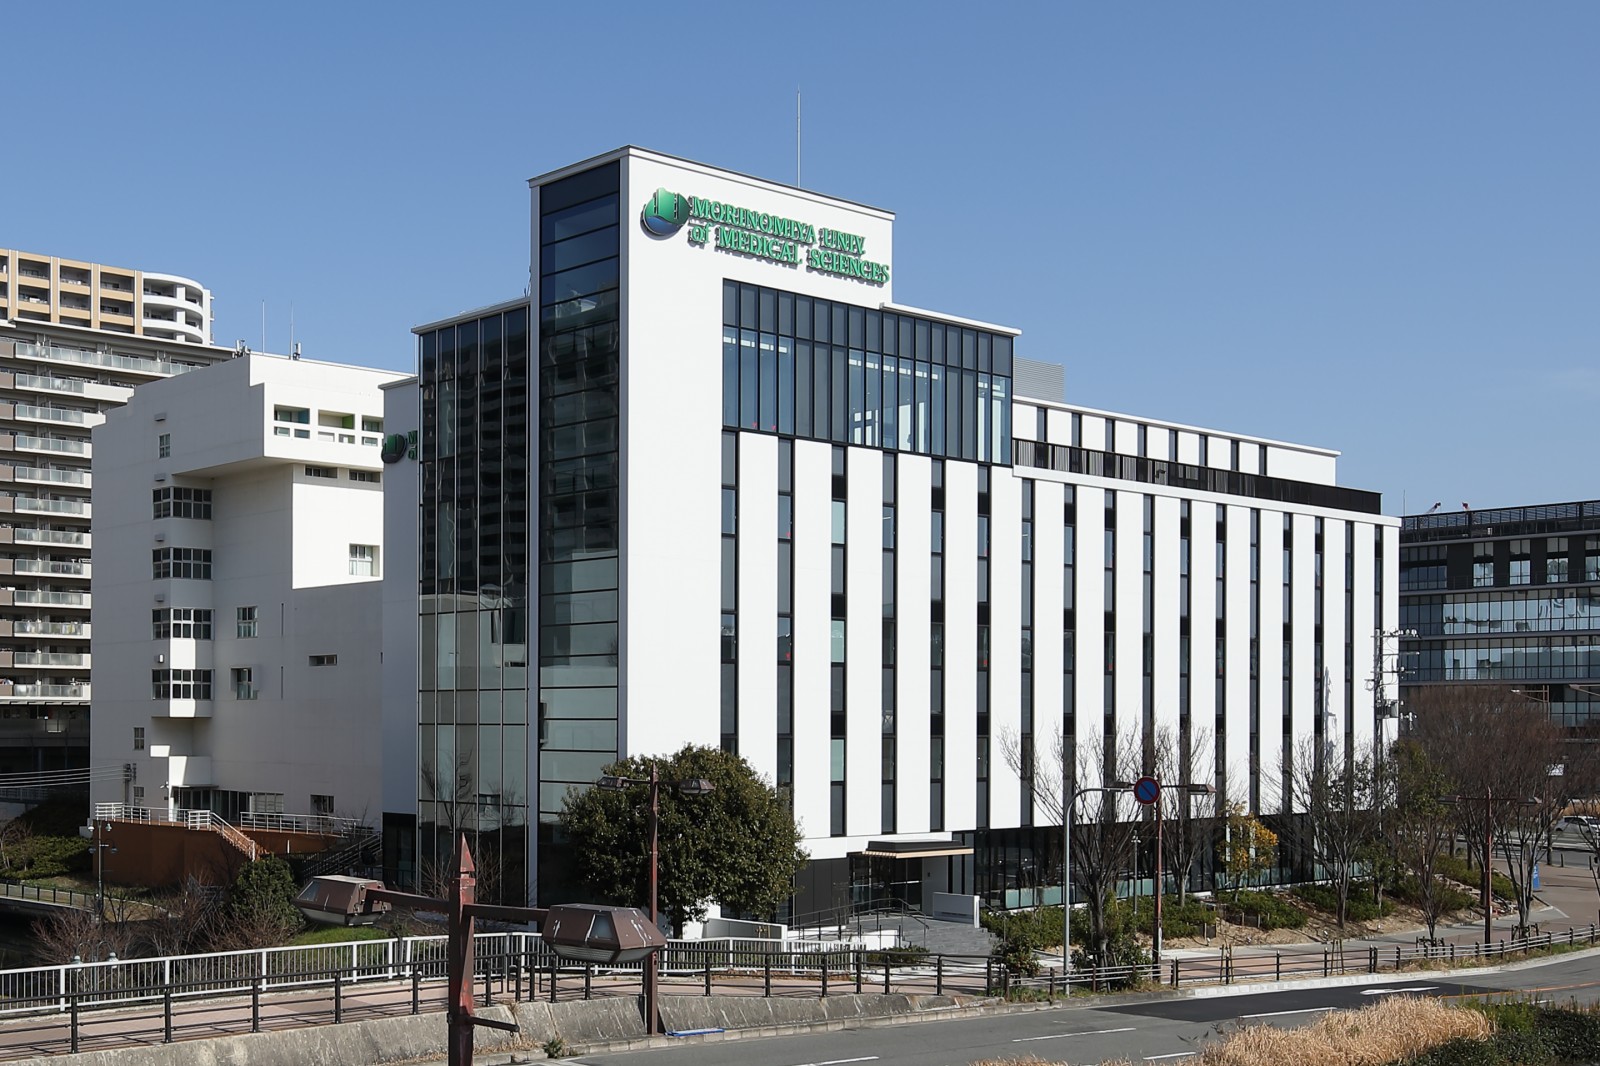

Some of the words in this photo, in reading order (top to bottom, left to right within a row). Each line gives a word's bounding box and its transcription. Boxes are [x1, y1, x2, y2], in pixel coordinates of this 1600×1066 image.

[691, 196, 817, 244] MORINOMIYA
[689, 222, 712, 244] of
[716, 226, 803, 264] MEDICAL
[807, 248, 890, 283] SCIENCES
